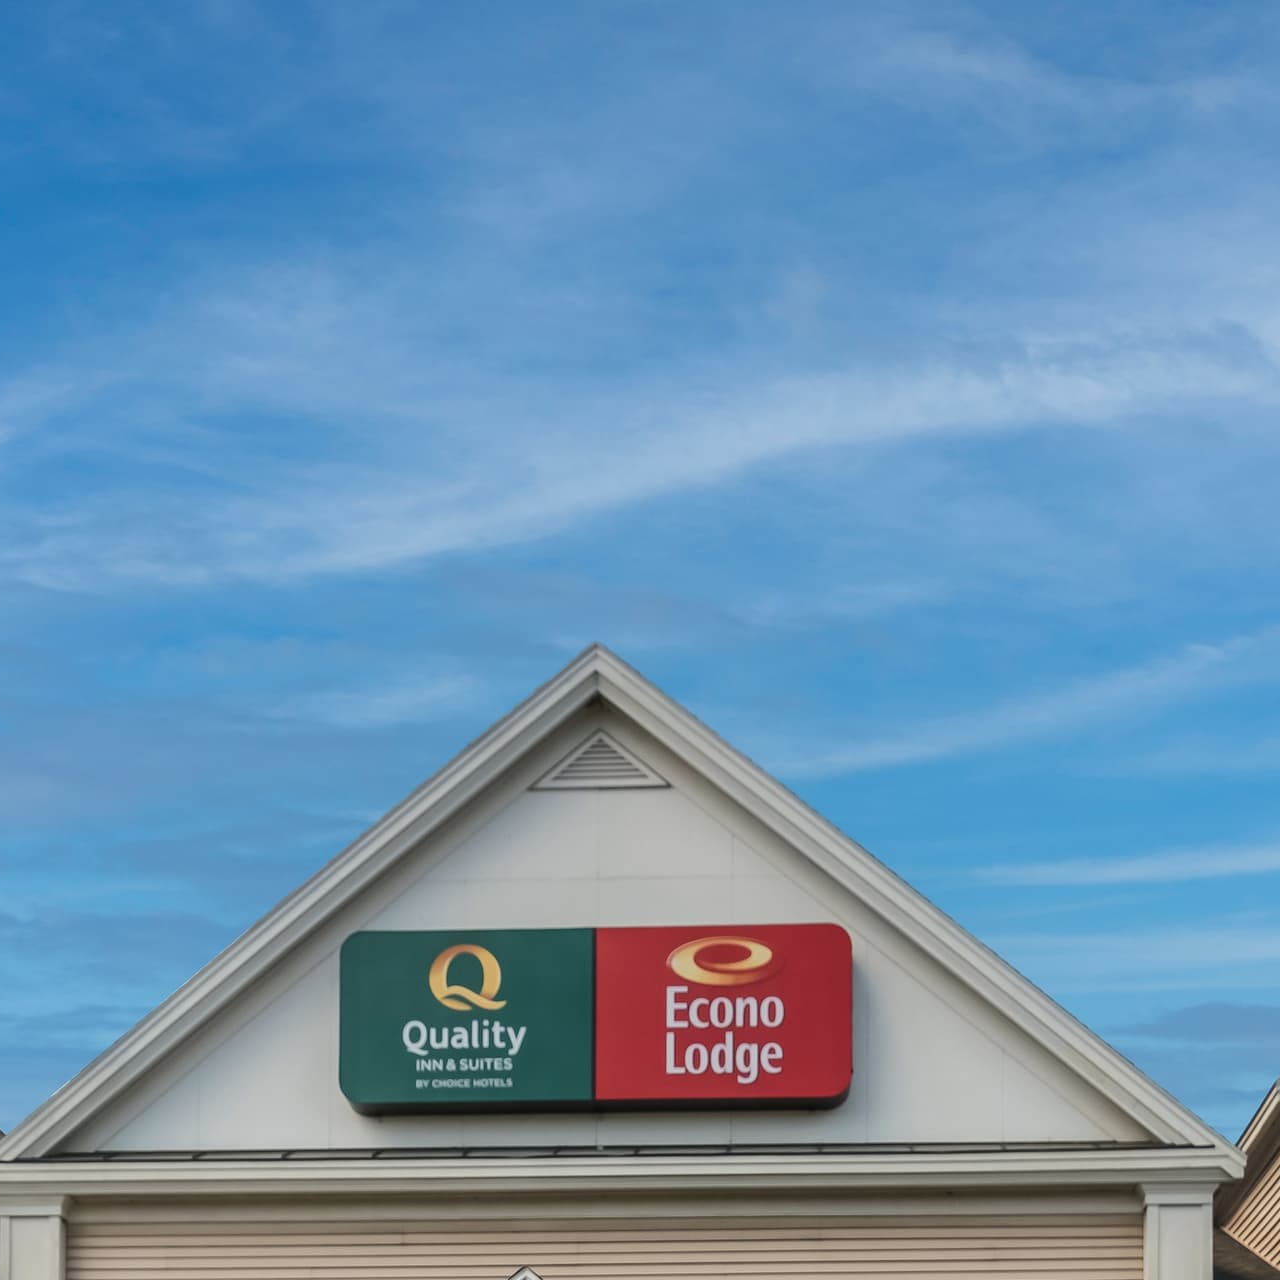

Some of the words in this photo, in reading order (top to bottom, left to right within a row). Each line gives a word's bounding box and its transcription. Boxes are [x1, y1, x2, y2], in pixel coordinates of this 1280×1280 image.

[666, 985, 784, 1028] Econo
[402, 1019, 527, 1056] Quality
[415, 1059, 444, 1072] INN
[446, 1059, 457, 1071] &
[459, 1057, 513, 1071] SUITES
[666, 1031, 783, 1084] Lodge
[415, 1079, 430, 1089] BY
[431, 1079, 471, 1088] CHOICE
[473, 1078, 513, 1088] HOTELS
